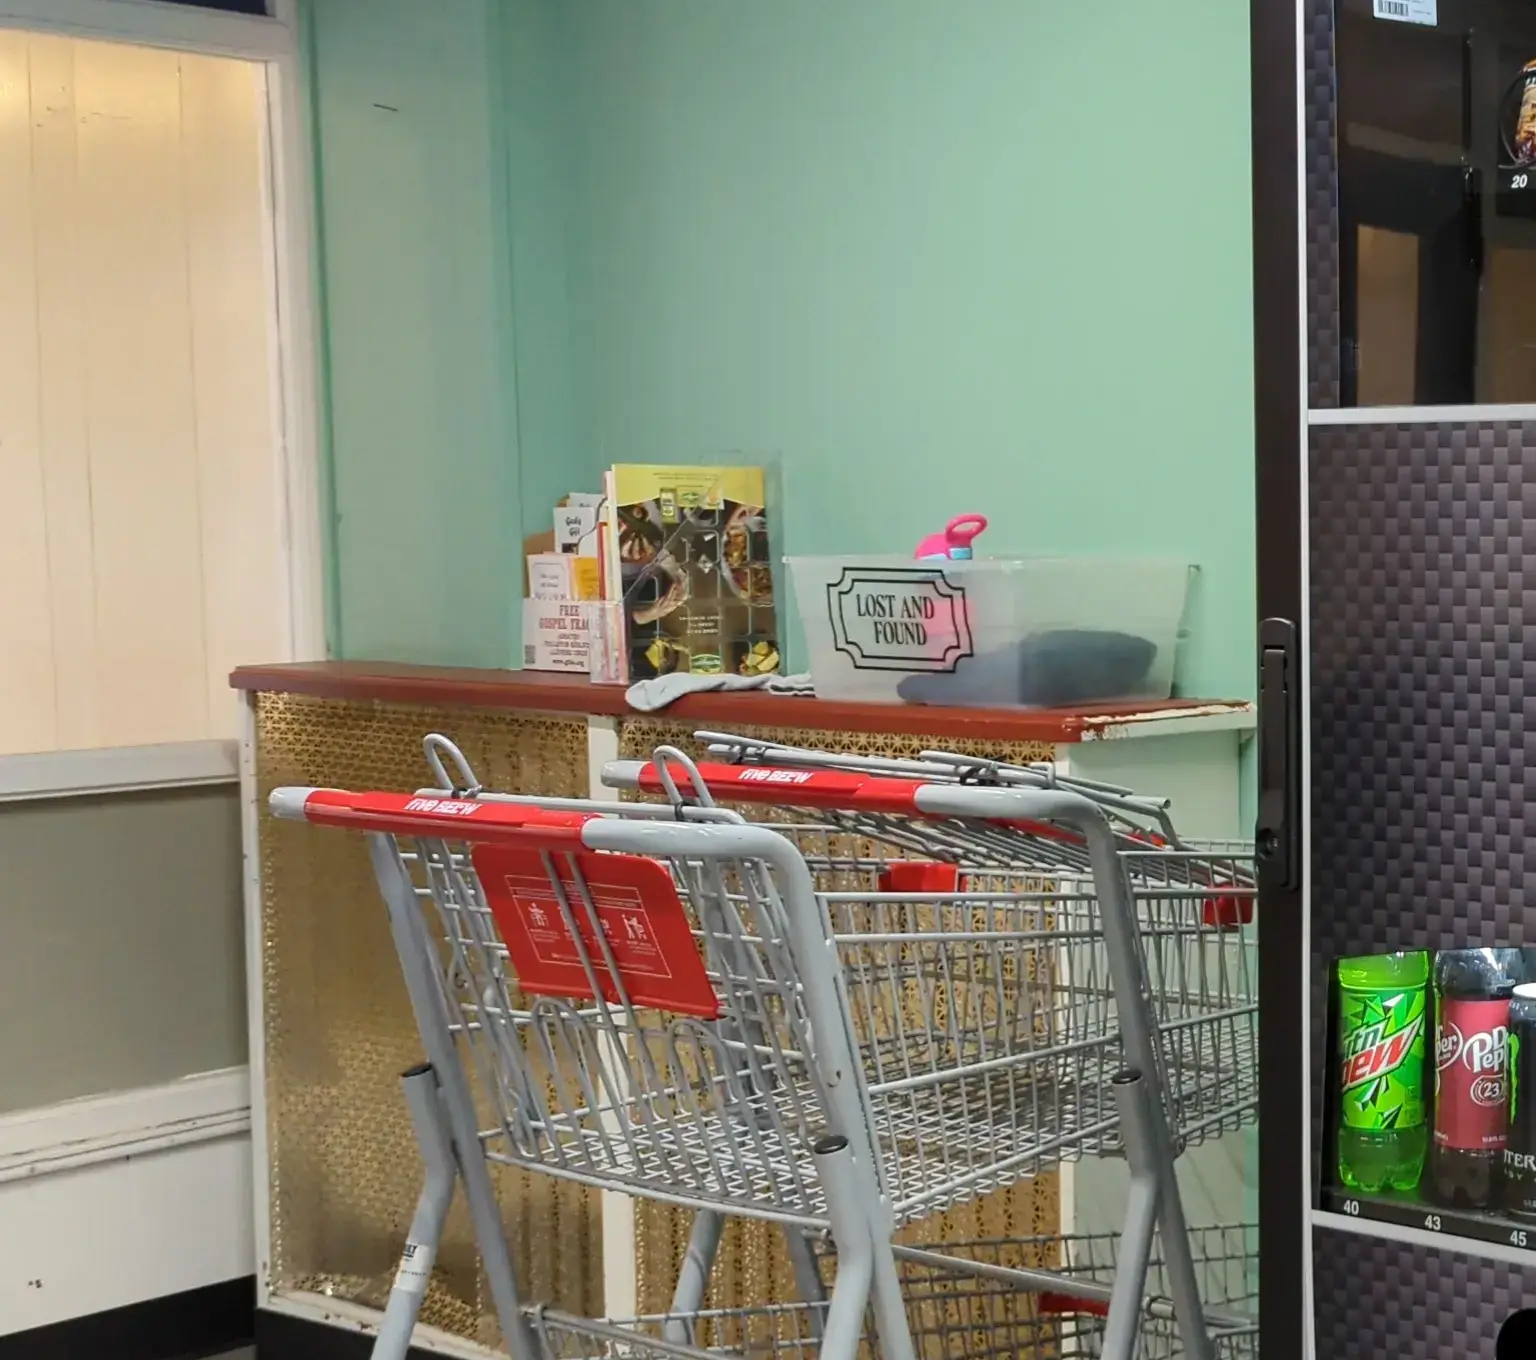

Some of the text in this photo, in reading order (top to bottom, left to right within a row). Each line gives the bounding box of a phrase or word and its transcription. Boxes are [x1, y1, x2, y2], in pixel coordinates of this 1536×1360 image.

[1511, 174, 1528, 189] 20
[559, 604, 580, 617] FREE
[856, 593, 935, 619] LOST AND
[538, 617, 568, 630] GOSPEL
[873, 621, 927, 645] FOUND
[1463, 1032, 1506, 1073] Pep
[1483, 1081, 1500, 1097] 23
[1343, 1200, 1360, 1216] 40
[1424, 1214, 1441, 1231] 43
[1510, 1231, 1527, 1246] 45
